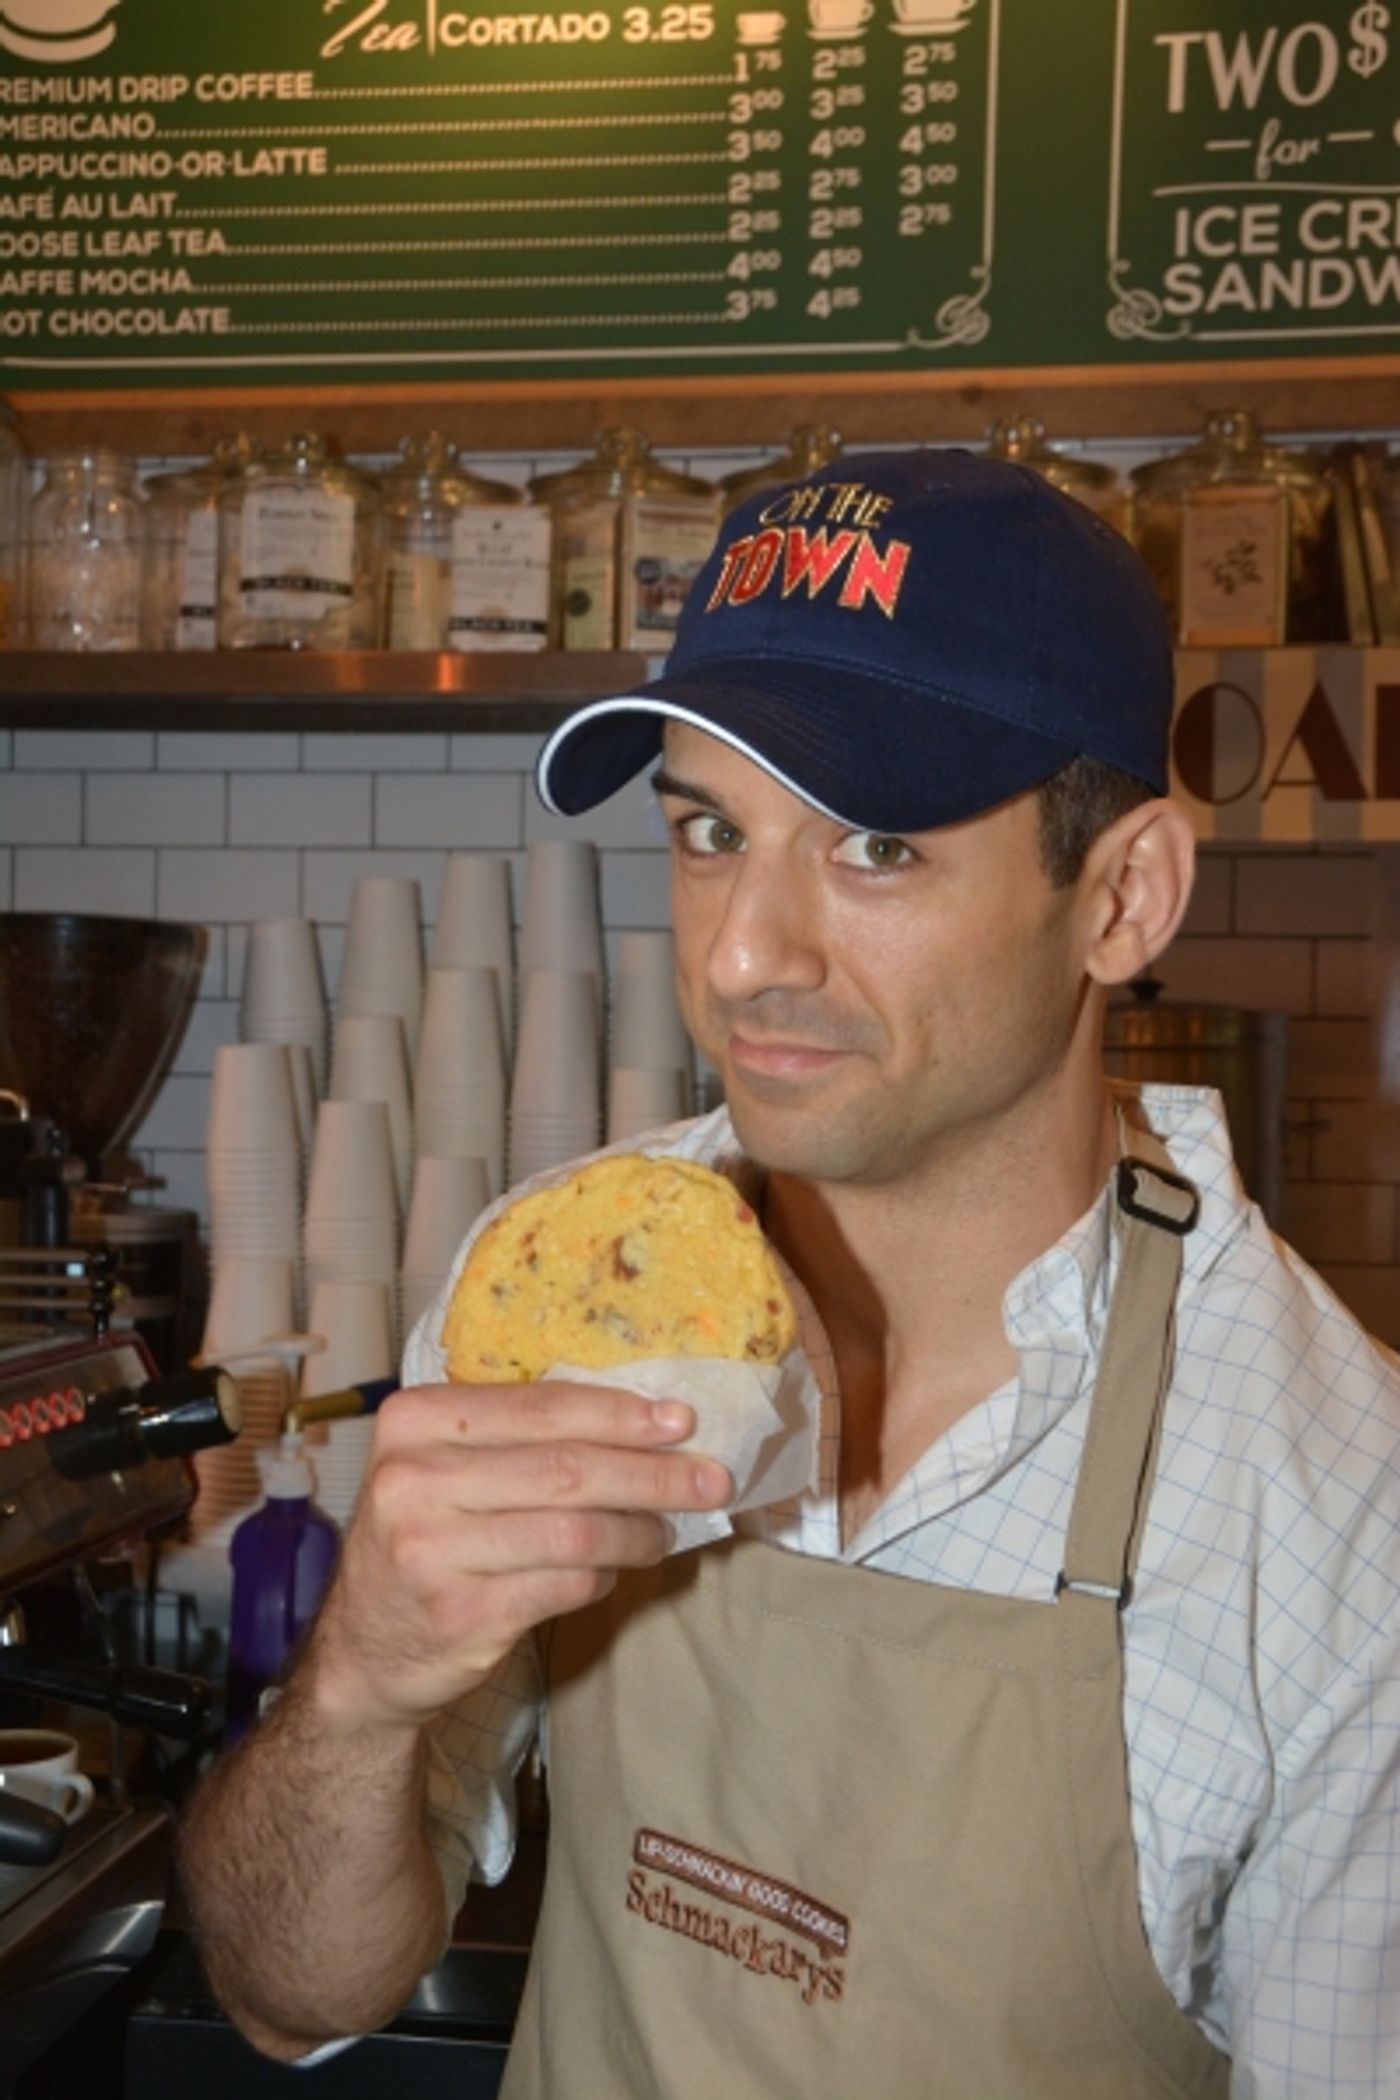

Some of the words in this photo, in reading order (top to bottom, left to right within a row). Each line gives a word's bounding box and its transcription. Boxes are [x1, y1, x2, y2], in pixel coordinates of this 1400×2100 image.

[319, 0, 421, 58] Tea
[622, 5, 715, 42] 3.25
[118, 75, 190, 102] DRIP
[195, 72, 315, 101] COFFEE
[1153, 22, 1340, 113] TWO
[0, 113, 156, 140] MERICANO
[1255, 117, 1320, 181] for
[0, 186, 54, 219] AFÉ
[60, 193, 104, 220] AU
[109, 191, 177, 219] LAIT
[1174, 204, 1281, 258] ICE
[1298, 198, 1400, 252] CR
[0, 231, 79, 258] OOSE
[85, 229, 162, 257] LEAF
[168, 228, 227, 256] TEA
[0, 269, 75, 295] AFFE
[80, 267, 192, 295] MOCHA
[1162, 256, 1400, 315] SANDW
[0, 308, 43, 337] OT
[49, 307, 230, 337] CHOCOLATE
[759, 484, 827, 525] ON
[825, 482, 893, 530] THE
[705, 525, 911, 621] TOWN
[1173, 680, 1400, 806] OA
